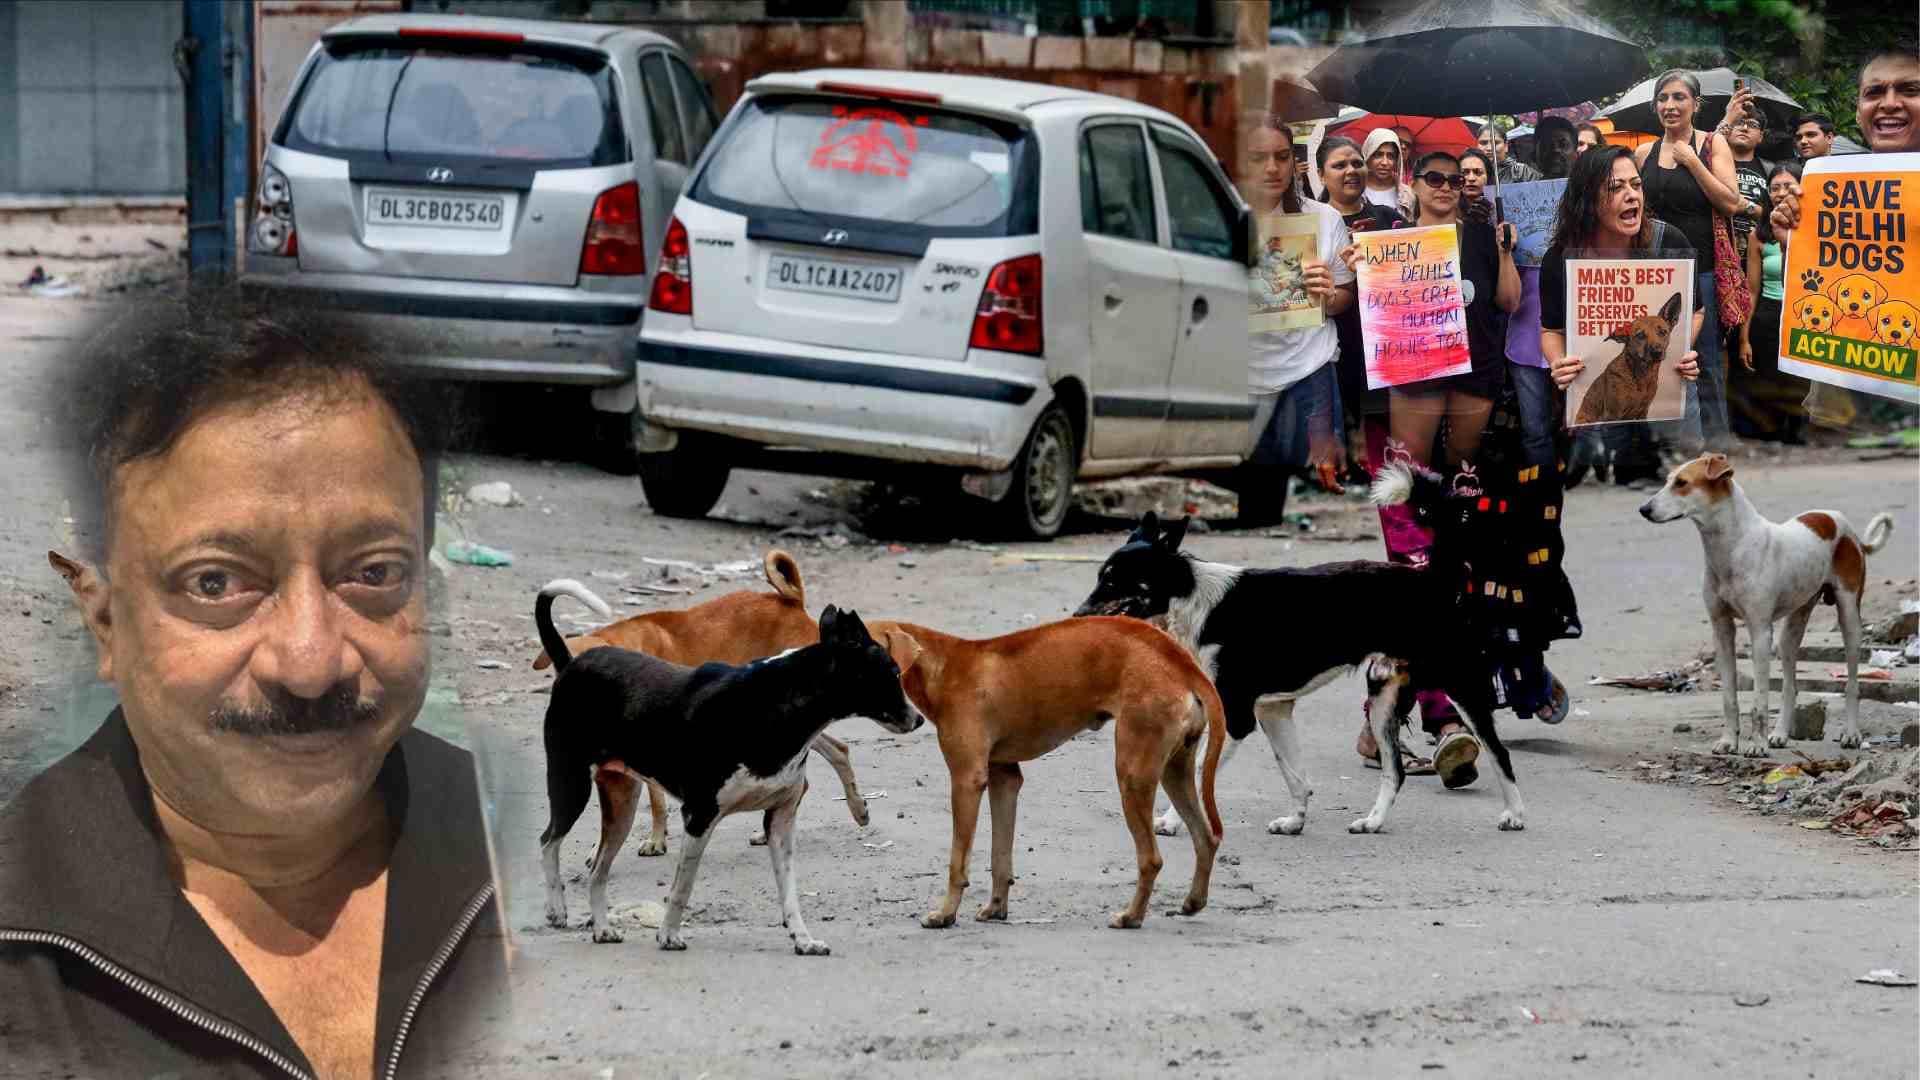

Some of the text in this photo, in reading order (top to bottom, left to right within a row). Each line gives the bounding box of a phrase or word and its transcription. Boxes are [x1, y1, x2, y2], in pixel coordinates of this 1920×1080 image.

[1822, 180, 1902, 210] SAVE
[1817, 210, 1906, 242] DELHI
[1365, 240, 1421, 265] WHEN
[1818, 240, 1905, 274] DOGS
[780, 261, 898, 294] DL1CAA2407
[1577, 267, 1675, 286] MAN'S BEST
[1577, 286, 1635, 304] FRIEND
[1577, 304, 1649, 320] DESERVES
[1577, 320, 1634, 337] BETTER
[1795, 333, 1909, 376] ACT NOW
